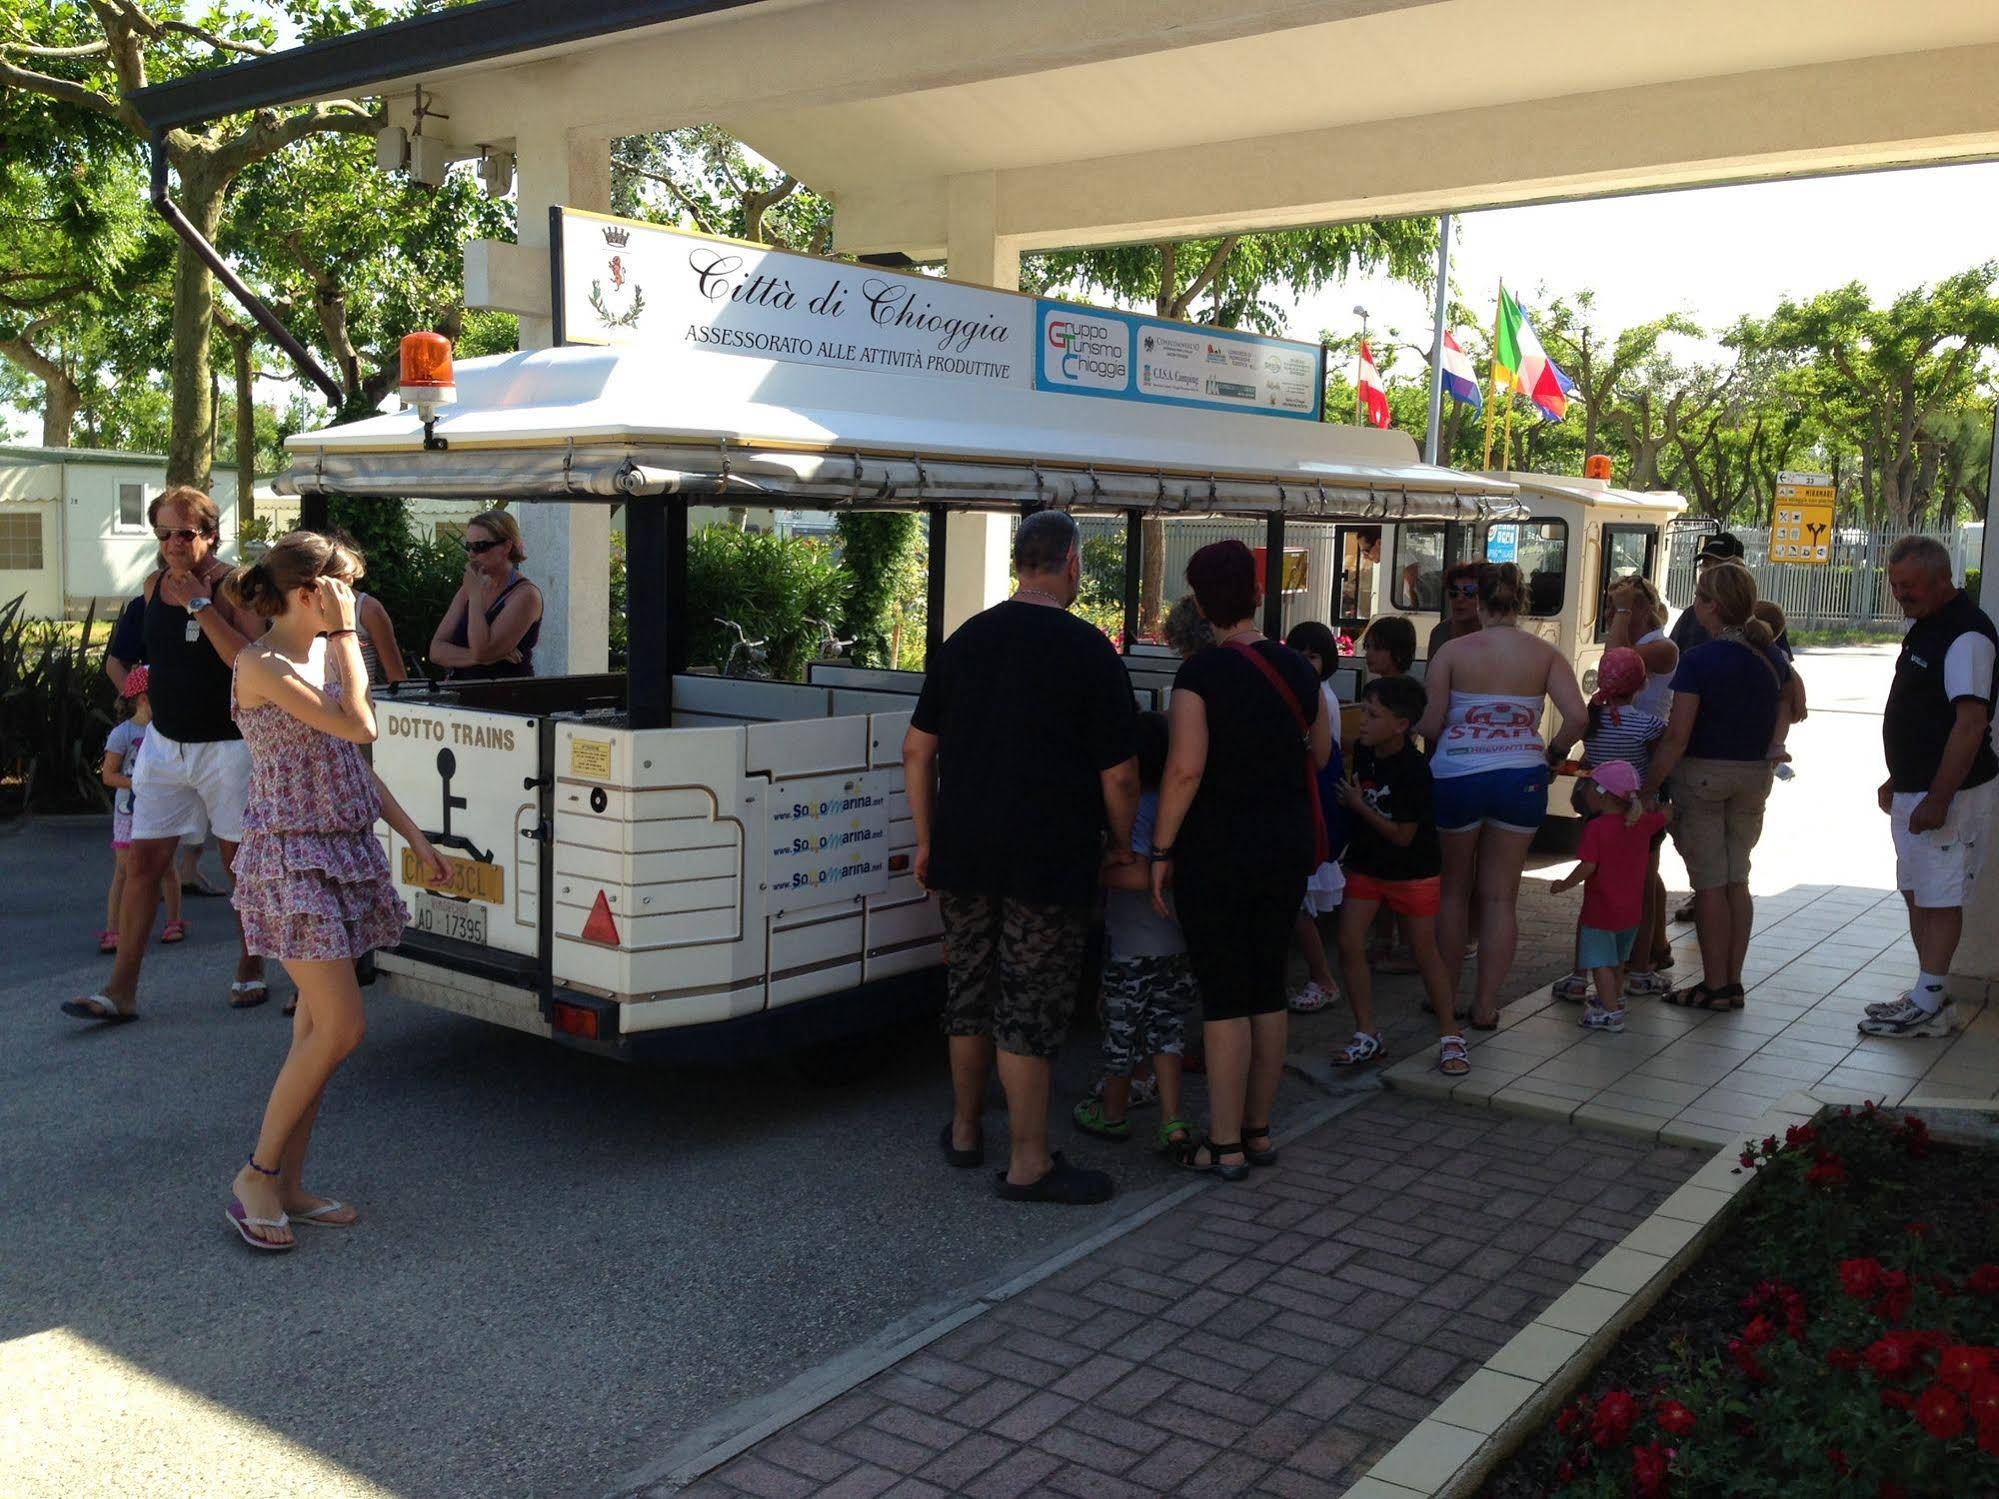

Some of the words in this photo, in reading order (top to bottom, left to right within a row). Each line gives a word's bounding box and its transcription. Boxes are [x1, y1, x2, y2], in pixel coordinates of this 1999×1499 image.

[689, 248, 798, 310] Città
[808, 281, 846, 317] di
[862, 278, 1009, 353] Chioggia
[685, 325, 812, 355] ASSESSORATO
[816, 342, 857, 361] ALLE
[859, 348, 922, 369] ATTIVITÀ
[926, 356, 1010, 379] PRODUTTIVE
[1048, 321, 1107, 349] Gruppo
[1062, 353, 1126, 380] Chioggia
[388, 715, 446, 742] DOTTO
[451, 723, 515, 751] TRAINS
[417, 909, 433, 930] AD
[445, 914, 482, 942] 17395
